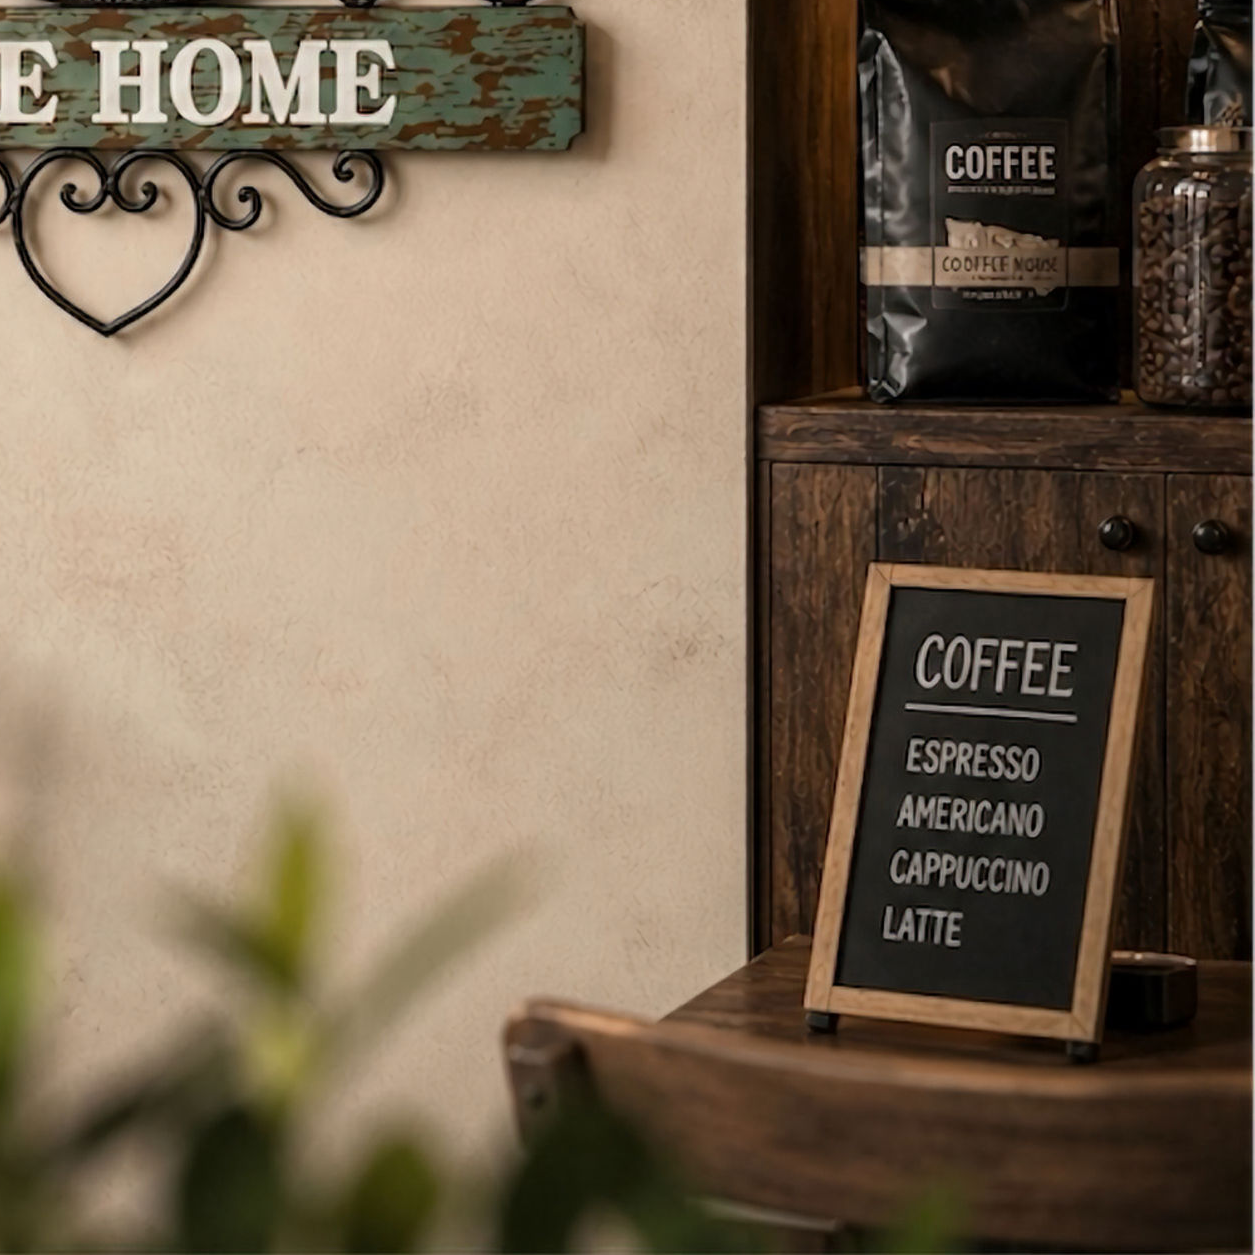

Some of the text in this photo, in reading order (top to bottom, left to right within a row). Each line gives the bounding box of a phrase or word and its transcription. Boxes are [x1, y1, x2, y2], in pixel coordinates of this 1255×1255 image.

[93, 38, 397, 126] HOME
[945, 145, 1057, 181] COFFEE
[914, 633, 1078, 698] COFFEE
[906, 737, 1041, 782] ESPRESSO
[896, 794, 1044, 838] AMERICANO
[889, 848, 1050, 896] CAPPUCCINO
[882, 906, 964, 947] LATTE
